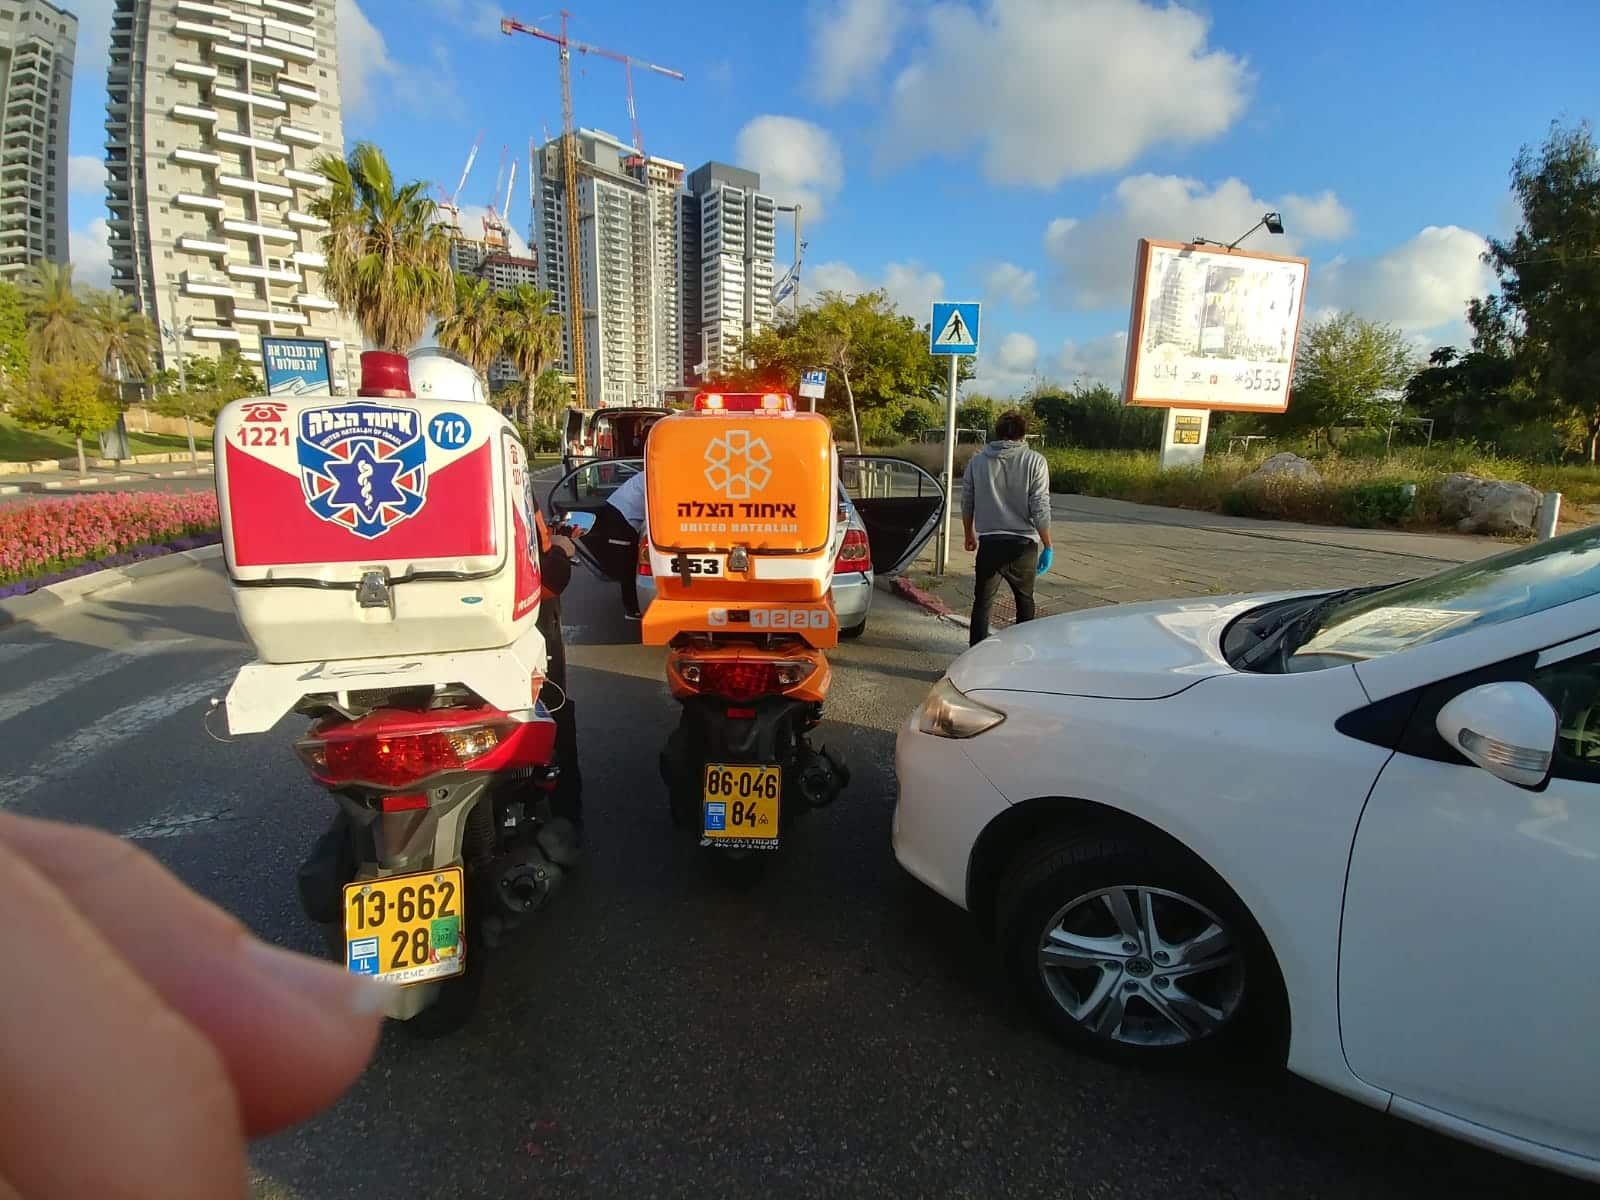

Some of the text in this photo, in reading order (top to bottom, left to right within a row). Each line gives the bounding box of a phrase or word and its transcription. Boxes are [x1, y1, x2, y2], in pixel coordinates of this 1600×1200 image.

[308, 410, 413, 437] איחוד הצלה
[434, 420, 465, 444] 712
[237, 427, 290, 446] 1221
[677, 500, 797, 518] איחוד הצלה
[680, 522, 798, 534] UNITED HATZALAH
[753, 610, 827, 626] 1221
[708, 770, 777, 799] 86-046
[731, 801, 757, 828] 84
[351, 881, 455, 930] 13-662
[391, 927, 430, 969] 28
[360, 958, 370, 970] IL
